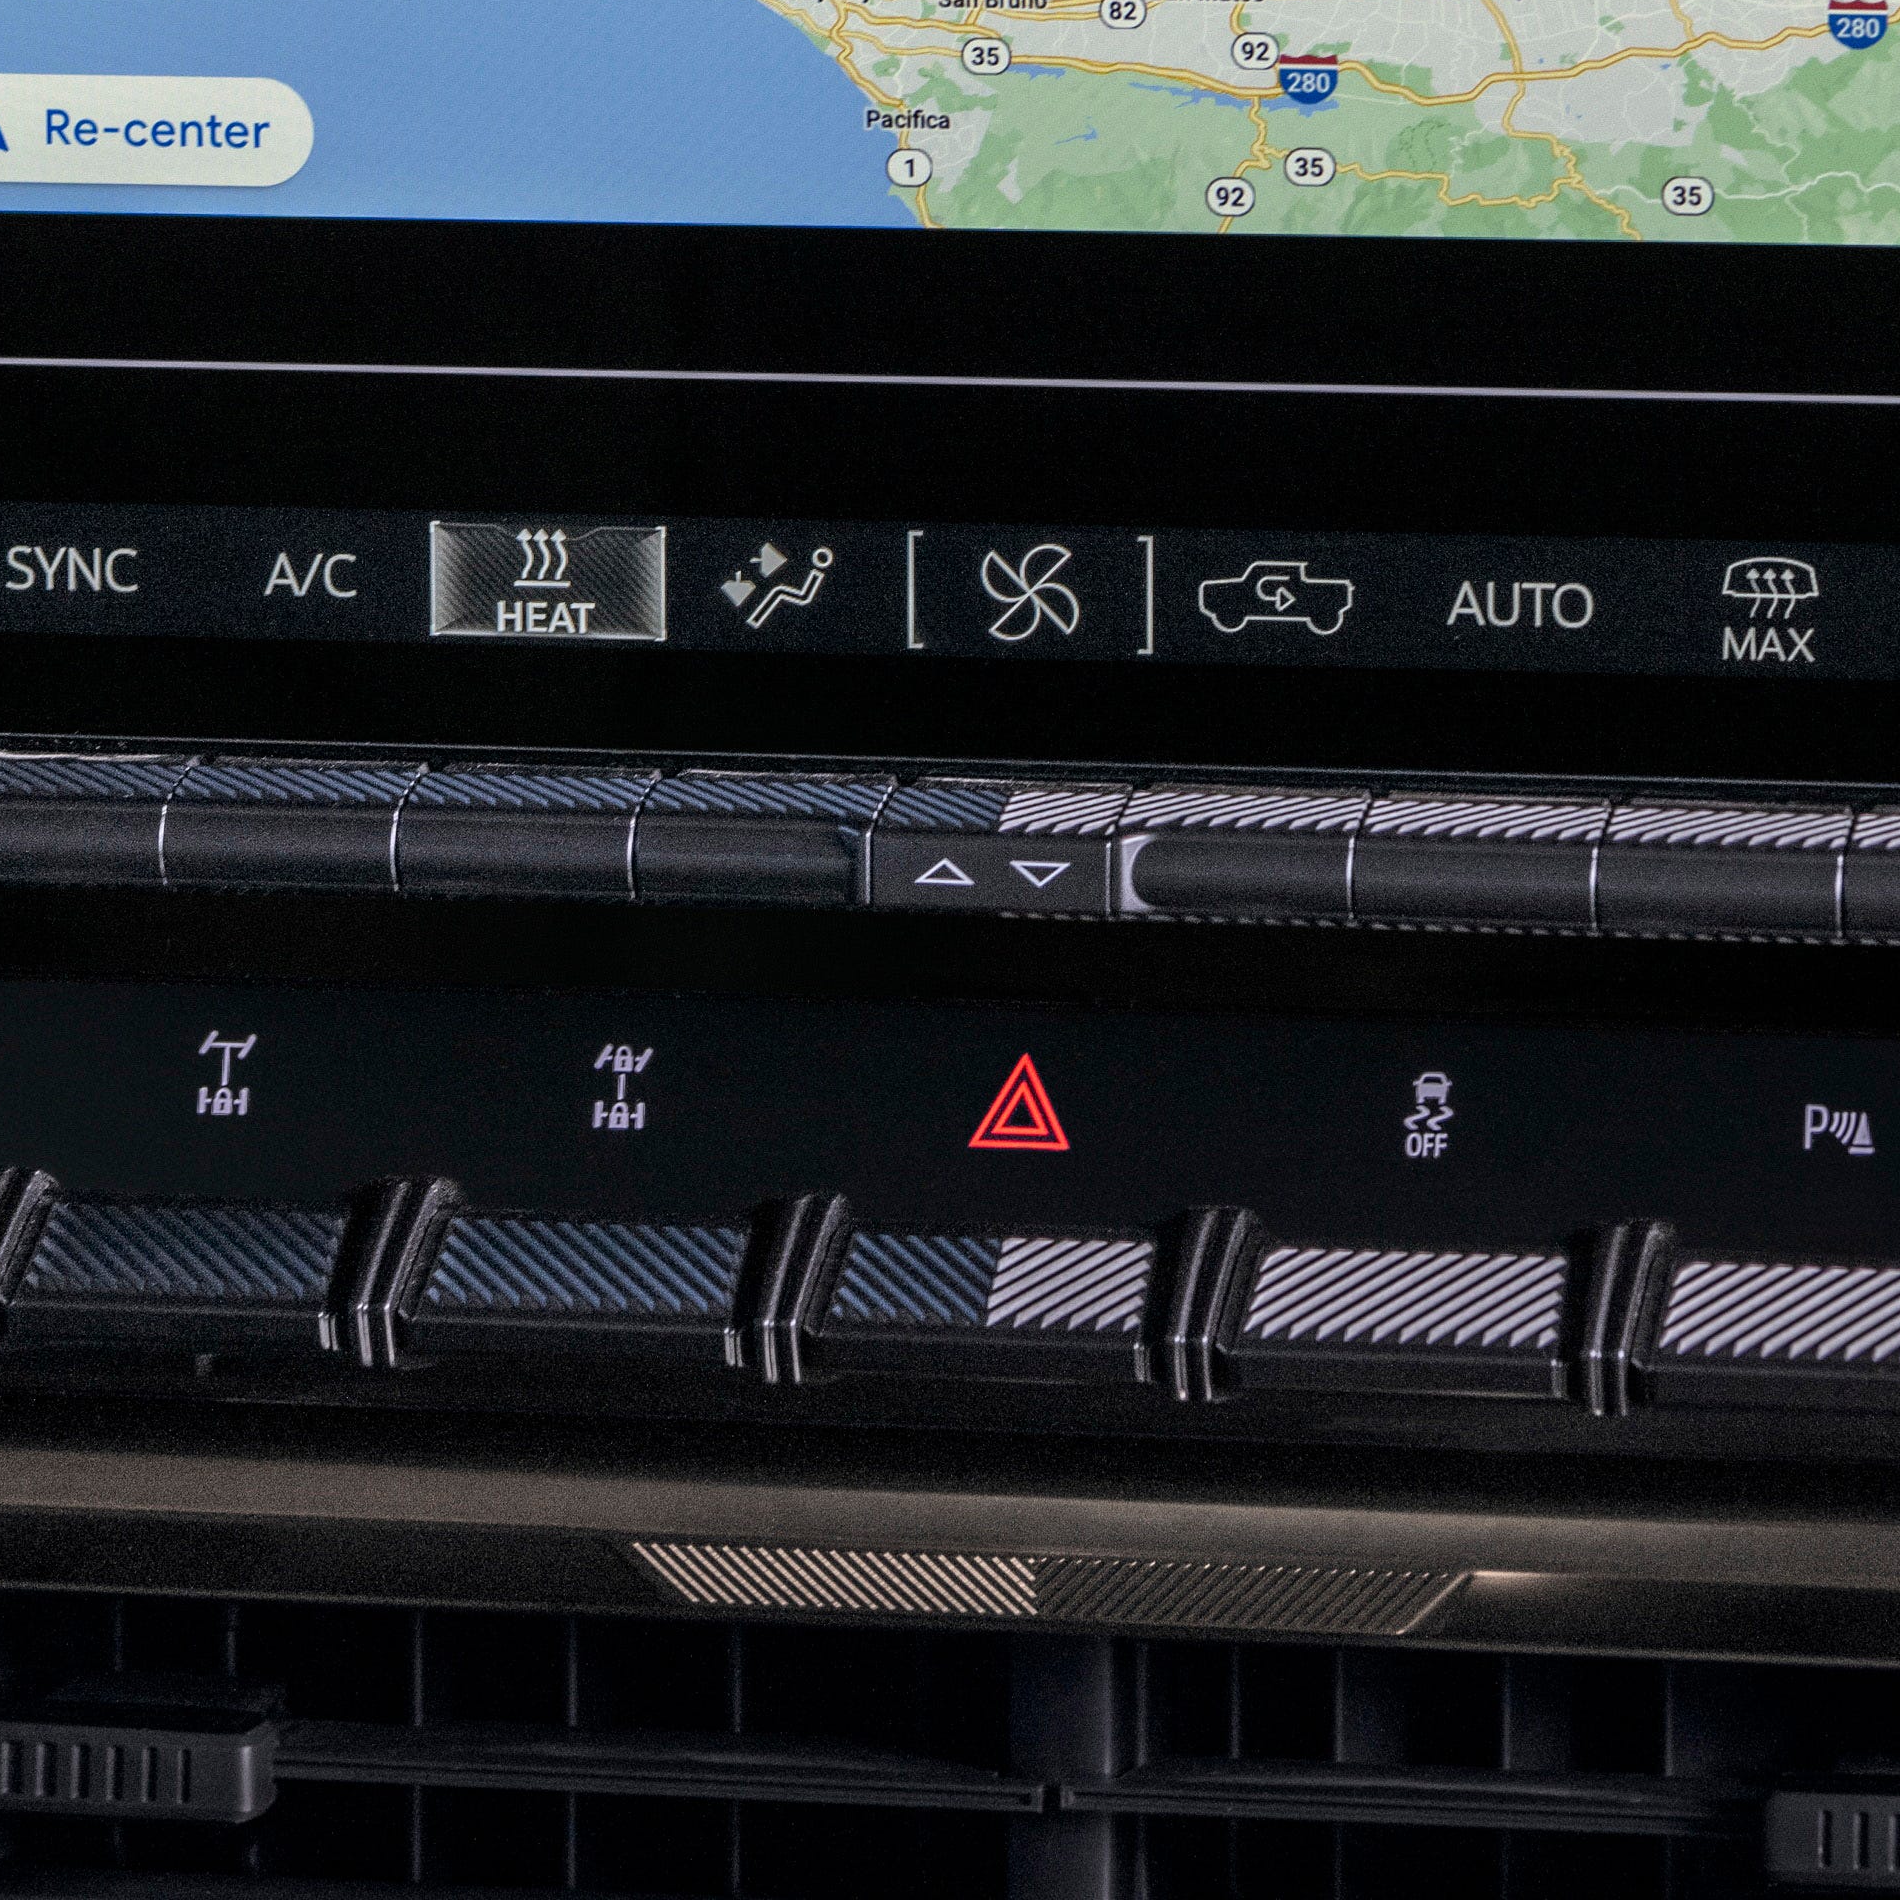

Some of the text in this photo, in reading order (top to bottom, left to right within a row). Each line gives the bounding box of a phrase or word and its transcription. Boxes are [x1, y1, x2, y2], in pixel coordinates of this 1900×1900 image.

[1109, 1, 1137, 20] 82
[1836, 18, 1880, 39] 280
[972, 47, 1001, 67] 35
[1241, 42, 1270, 61] 92
[1286, 72, 1331, 93] 280
[44, 108, 271, 150] Re-center
[866, 109, 951, 130] Pacifica
[904, 159, 915, 178] 1
[1294, 158, 1324, 178] 35
[1215, 187, 1245, 207] 92
[1672, 186, 1703, 206] 35
[4, 546, 140, 594] SYNC
[264, 552, 358, 599] A/C
[1447, 582, 1595, 630] AUTO
[496, 601, 596, 635] HEAT
[1721, 629, 1816, 664] MAX
[1404, 1131, 1449, 1160] OFF
